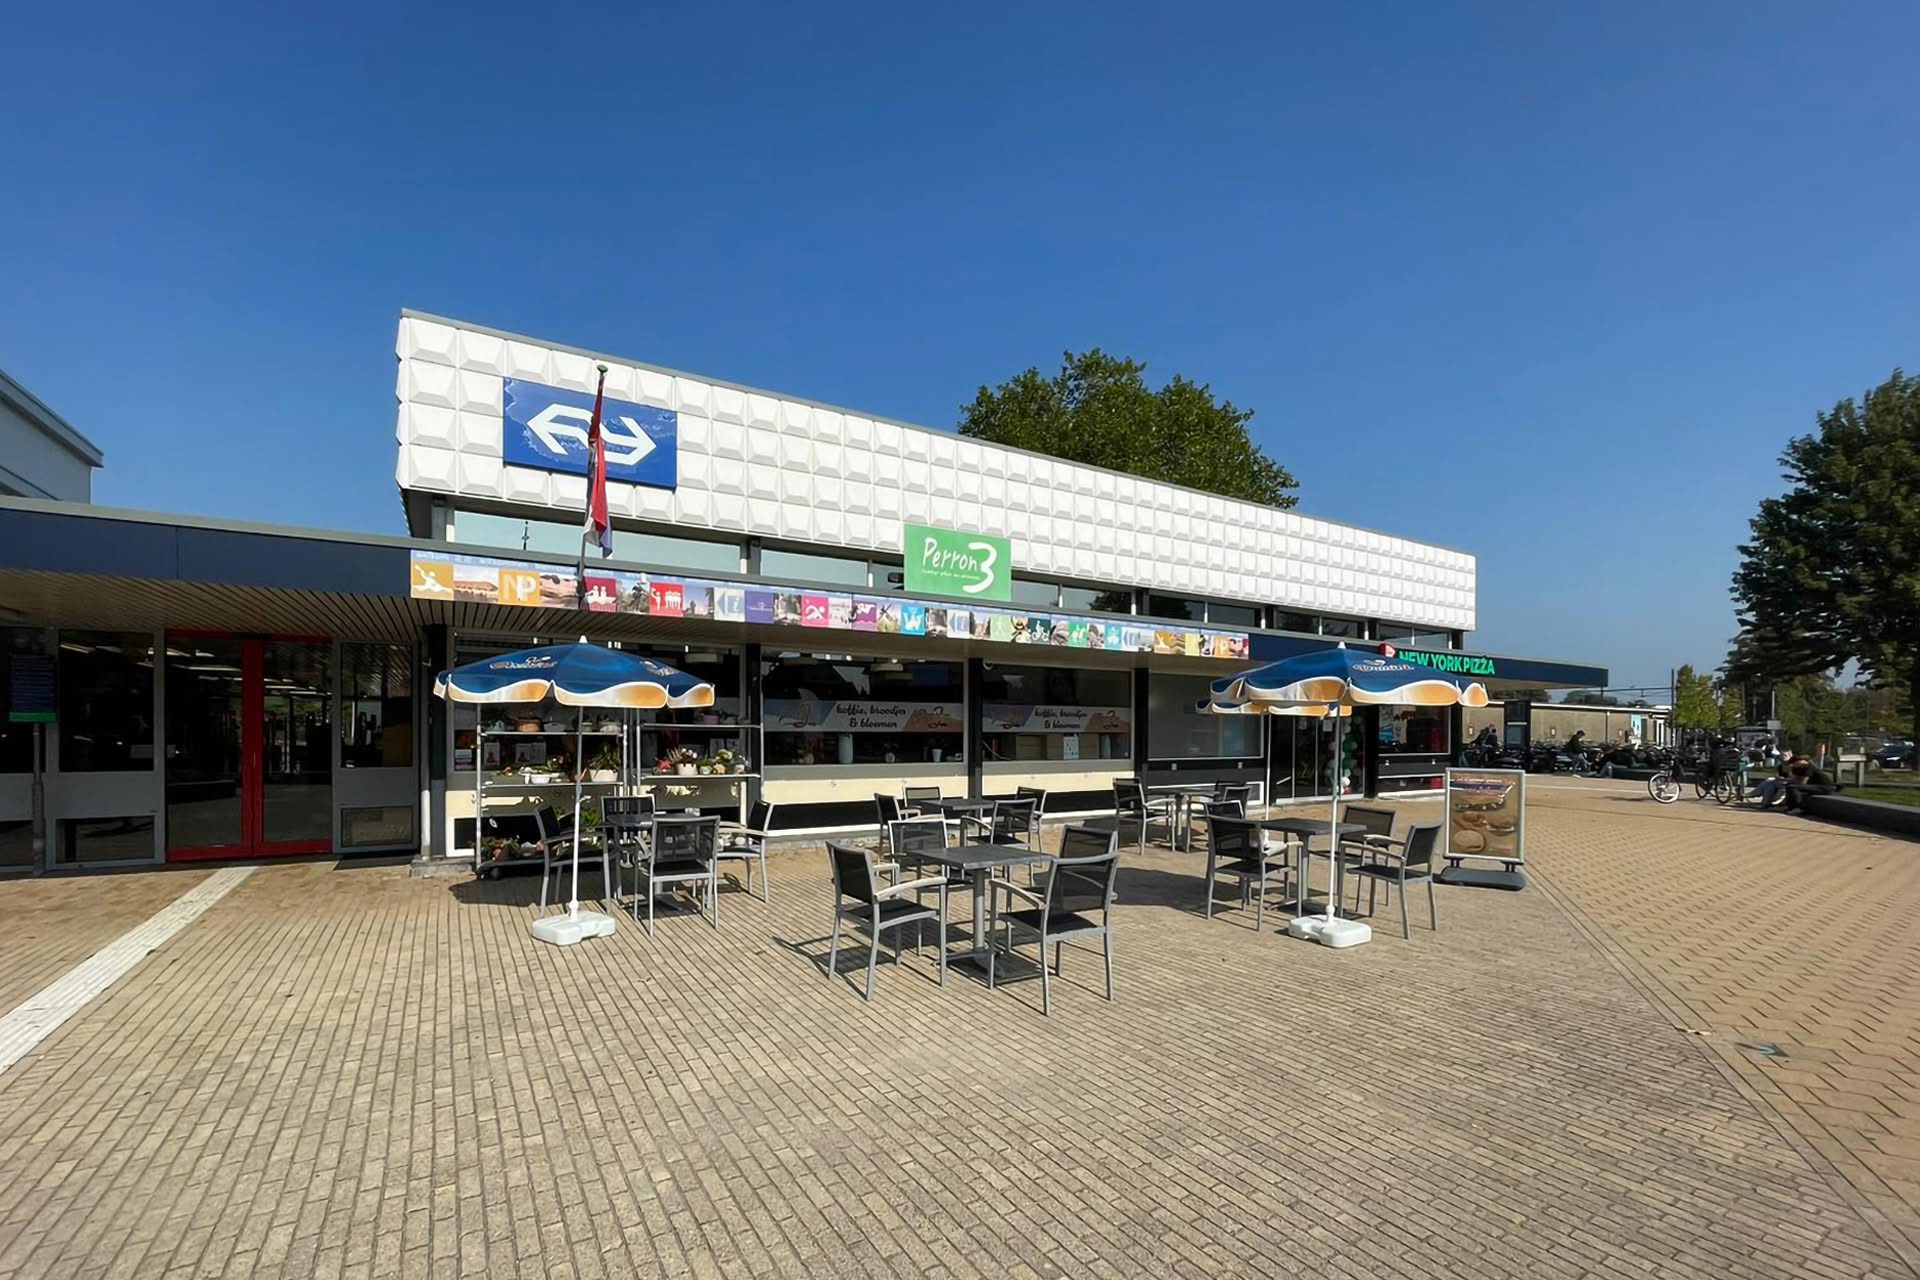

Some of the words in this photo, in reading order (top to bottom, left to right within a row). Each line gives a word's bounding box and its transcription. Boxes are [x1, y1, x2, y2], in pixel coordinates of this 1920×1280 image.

[922, 537, 978, 571] Perron
[962, 541, 998, 594] 3
[1398, 650, 1429, 667] NEW
[1431, 654, 1462, 672] YORK
[1463, 657, 1496, 675] PIZZA
